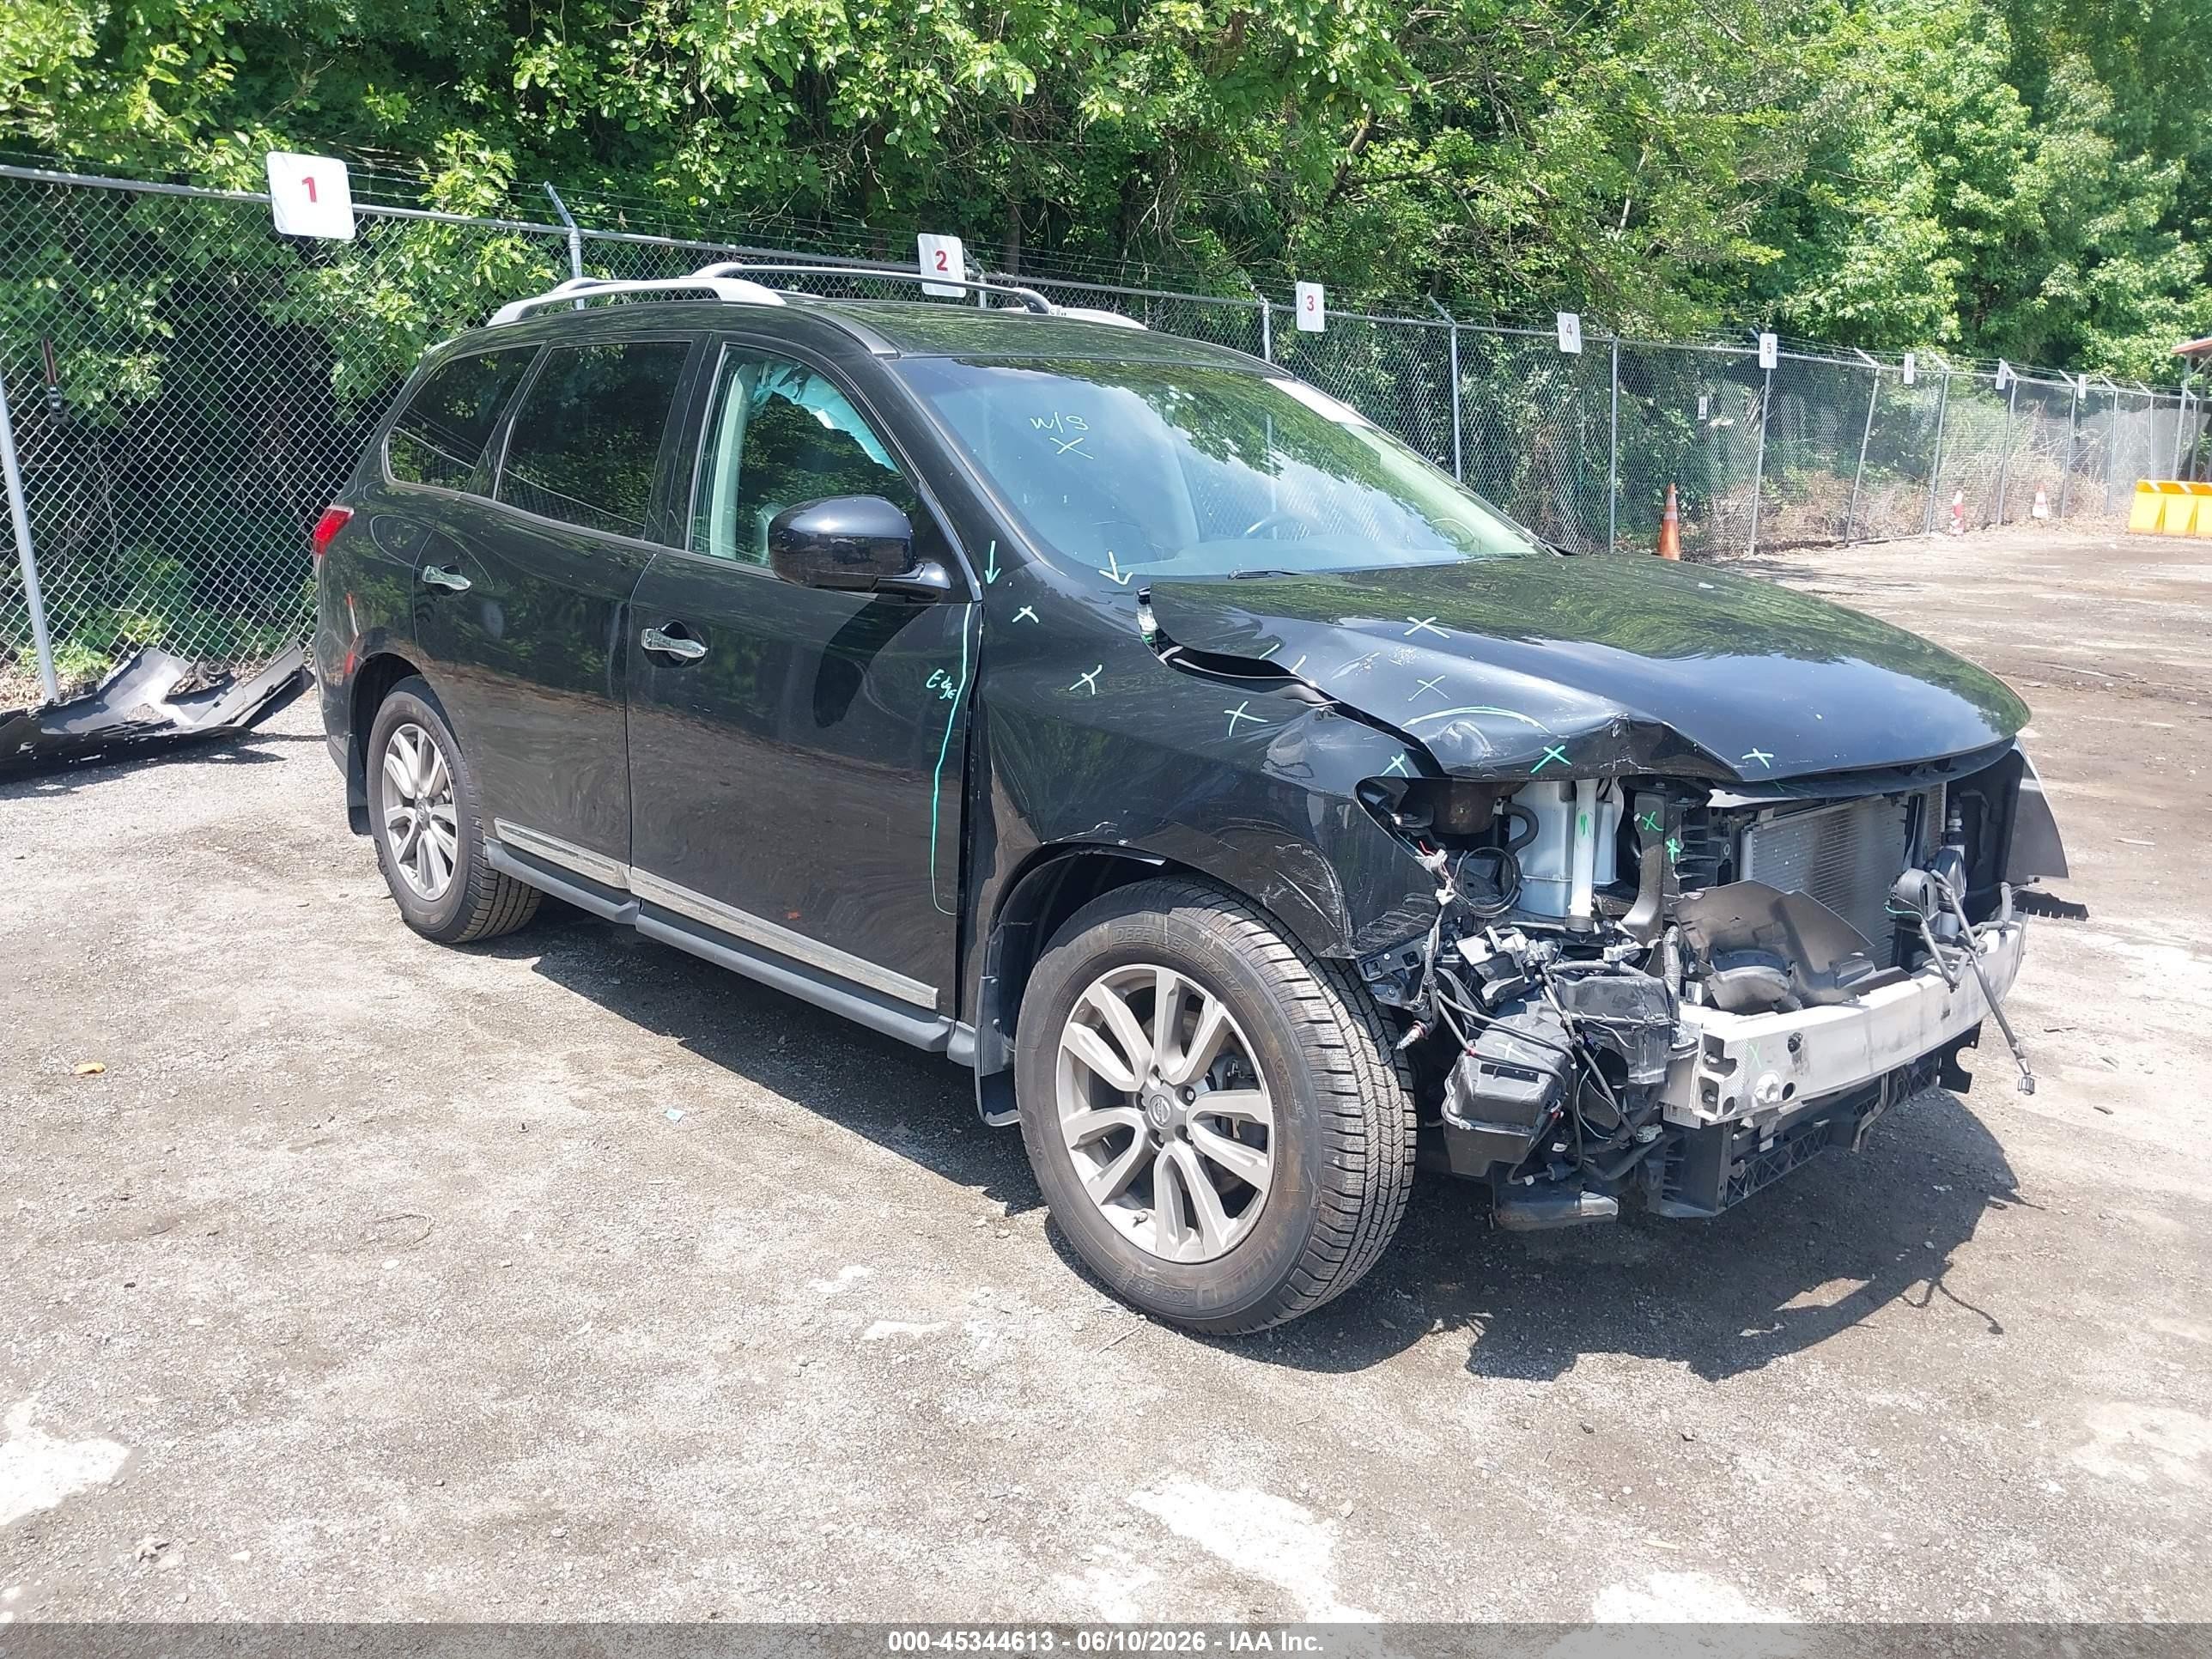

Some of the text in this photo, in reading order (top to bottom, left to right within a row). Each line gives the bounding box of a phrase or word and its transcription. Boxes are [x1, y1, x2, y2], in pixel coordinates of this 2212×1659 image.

[301, 176, 318, 204] 1
[935, 250, 948, 272] 2
[1306, 295, 1315, 312] 3
[1565, 323, 1574, 337] 4
[1765, 342, 1772, 355] 5
